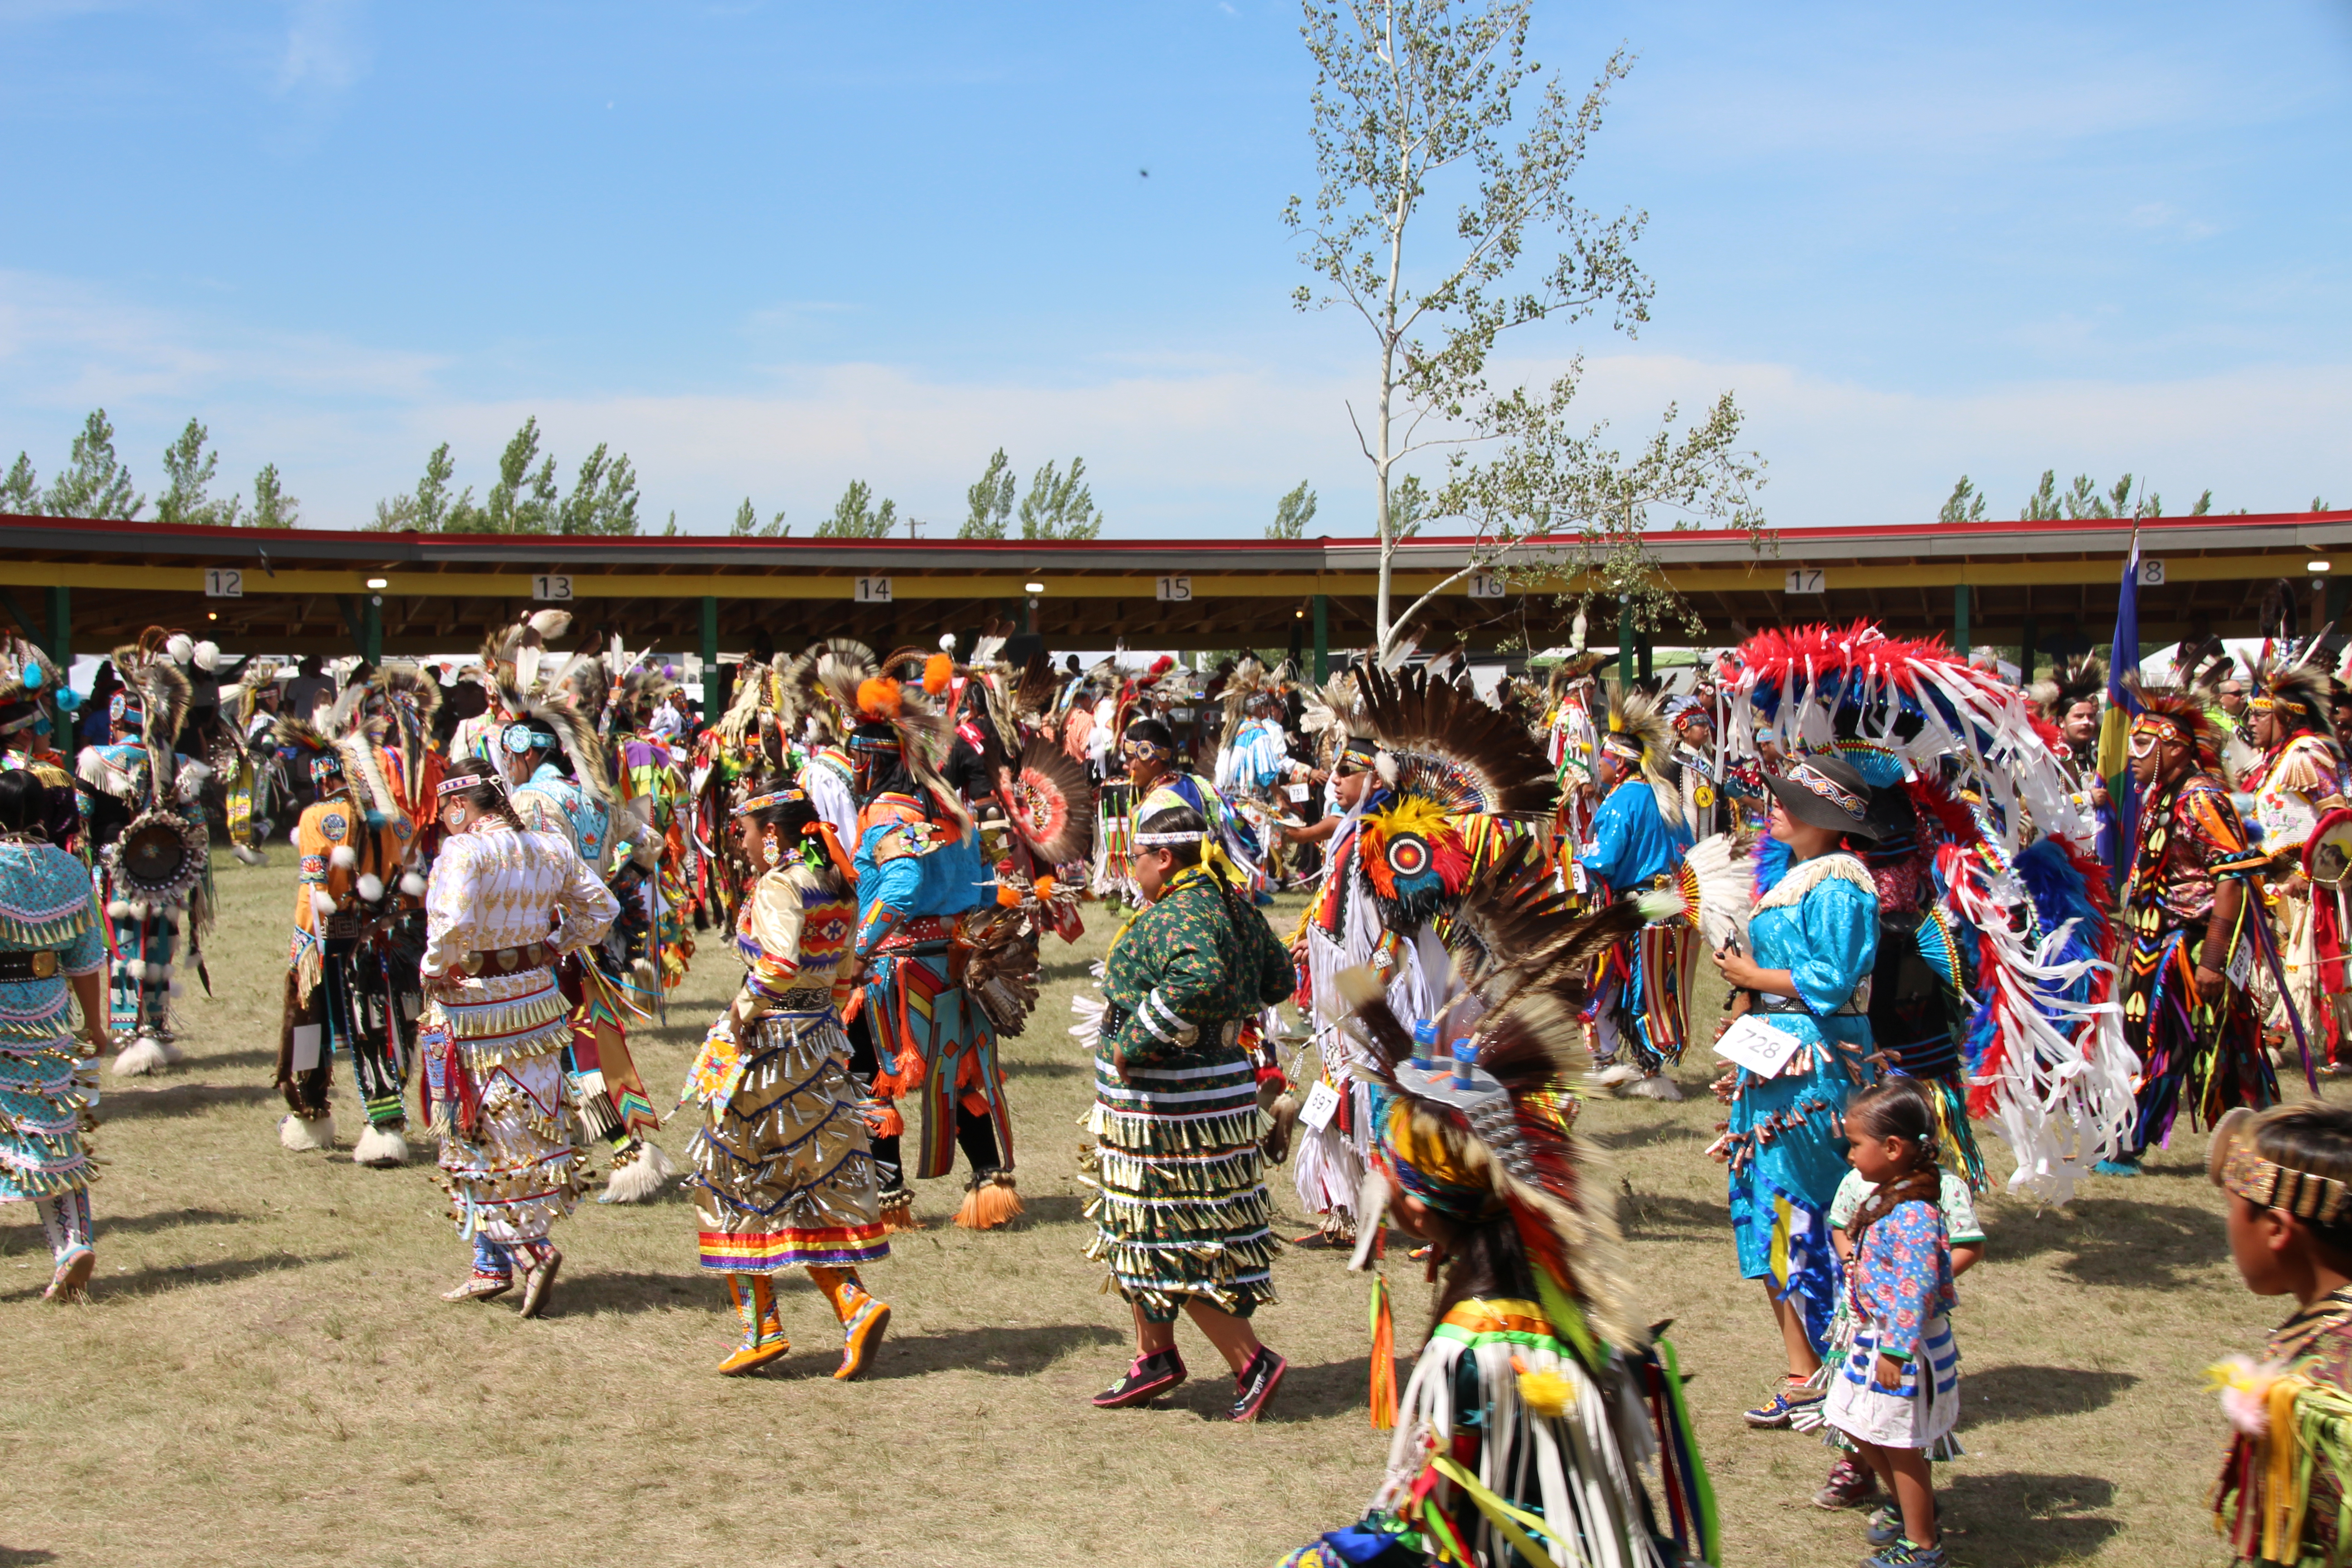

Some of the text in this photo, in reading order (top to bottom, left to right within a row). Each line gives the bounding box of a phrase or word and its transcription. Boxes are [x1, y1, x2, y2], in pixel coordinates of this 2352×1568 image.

[1791, 570, 1822, 592] 17
[2145, 561, 2161, 582] 8
[211, 571, 239, 594] 12
[539, 577, 570, 598] 13
[859, 578, 889, 600] 14
[1162, 578, 1190, 599] 15
[1474, 575, 1503, 596] 16
[1292, 788, 1303, 796] 731
[1736, 1028, 1781, 1058] 728
[1312, 1093, 1332, 1113] 697
